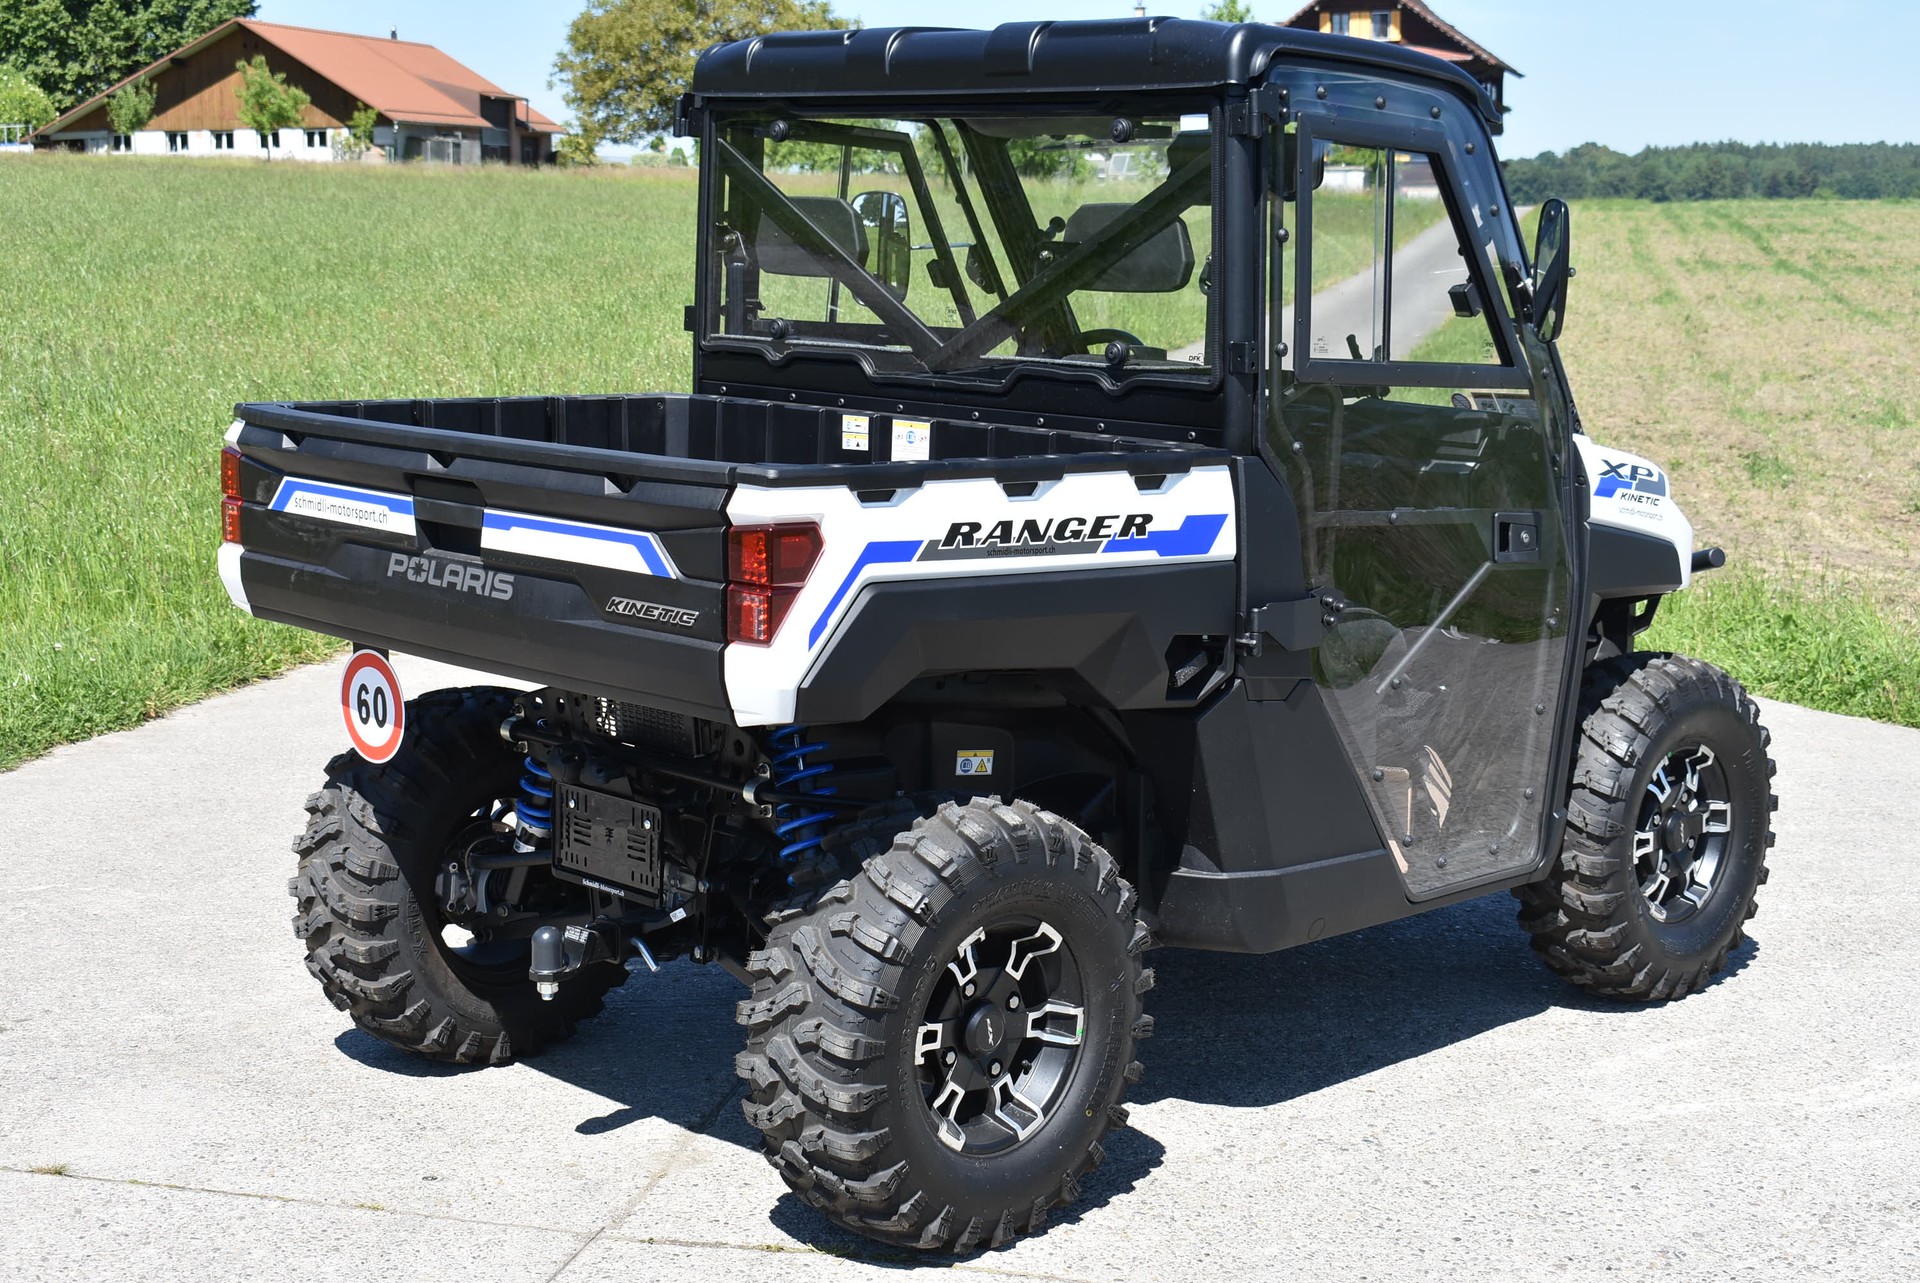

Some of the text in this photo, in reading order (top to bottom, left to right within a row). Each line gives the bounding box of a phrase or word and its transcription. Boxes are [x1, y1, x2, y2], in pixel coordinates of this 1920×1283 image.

[1598, 459, 1654, 481] XP
[294, 495, 388, 525] schmidli-motorsport.ch
[1620, 492, 1660, 507] KINETIC
[941, 513, 1154, 547] RANGER
[987, 545, 1056, 557] schmidli-motorsport.ch
[387, 552, 515, 600] POLARIS
[605, 596, 700, 626] KINETIC
[356, 683, 388, 729] 60
